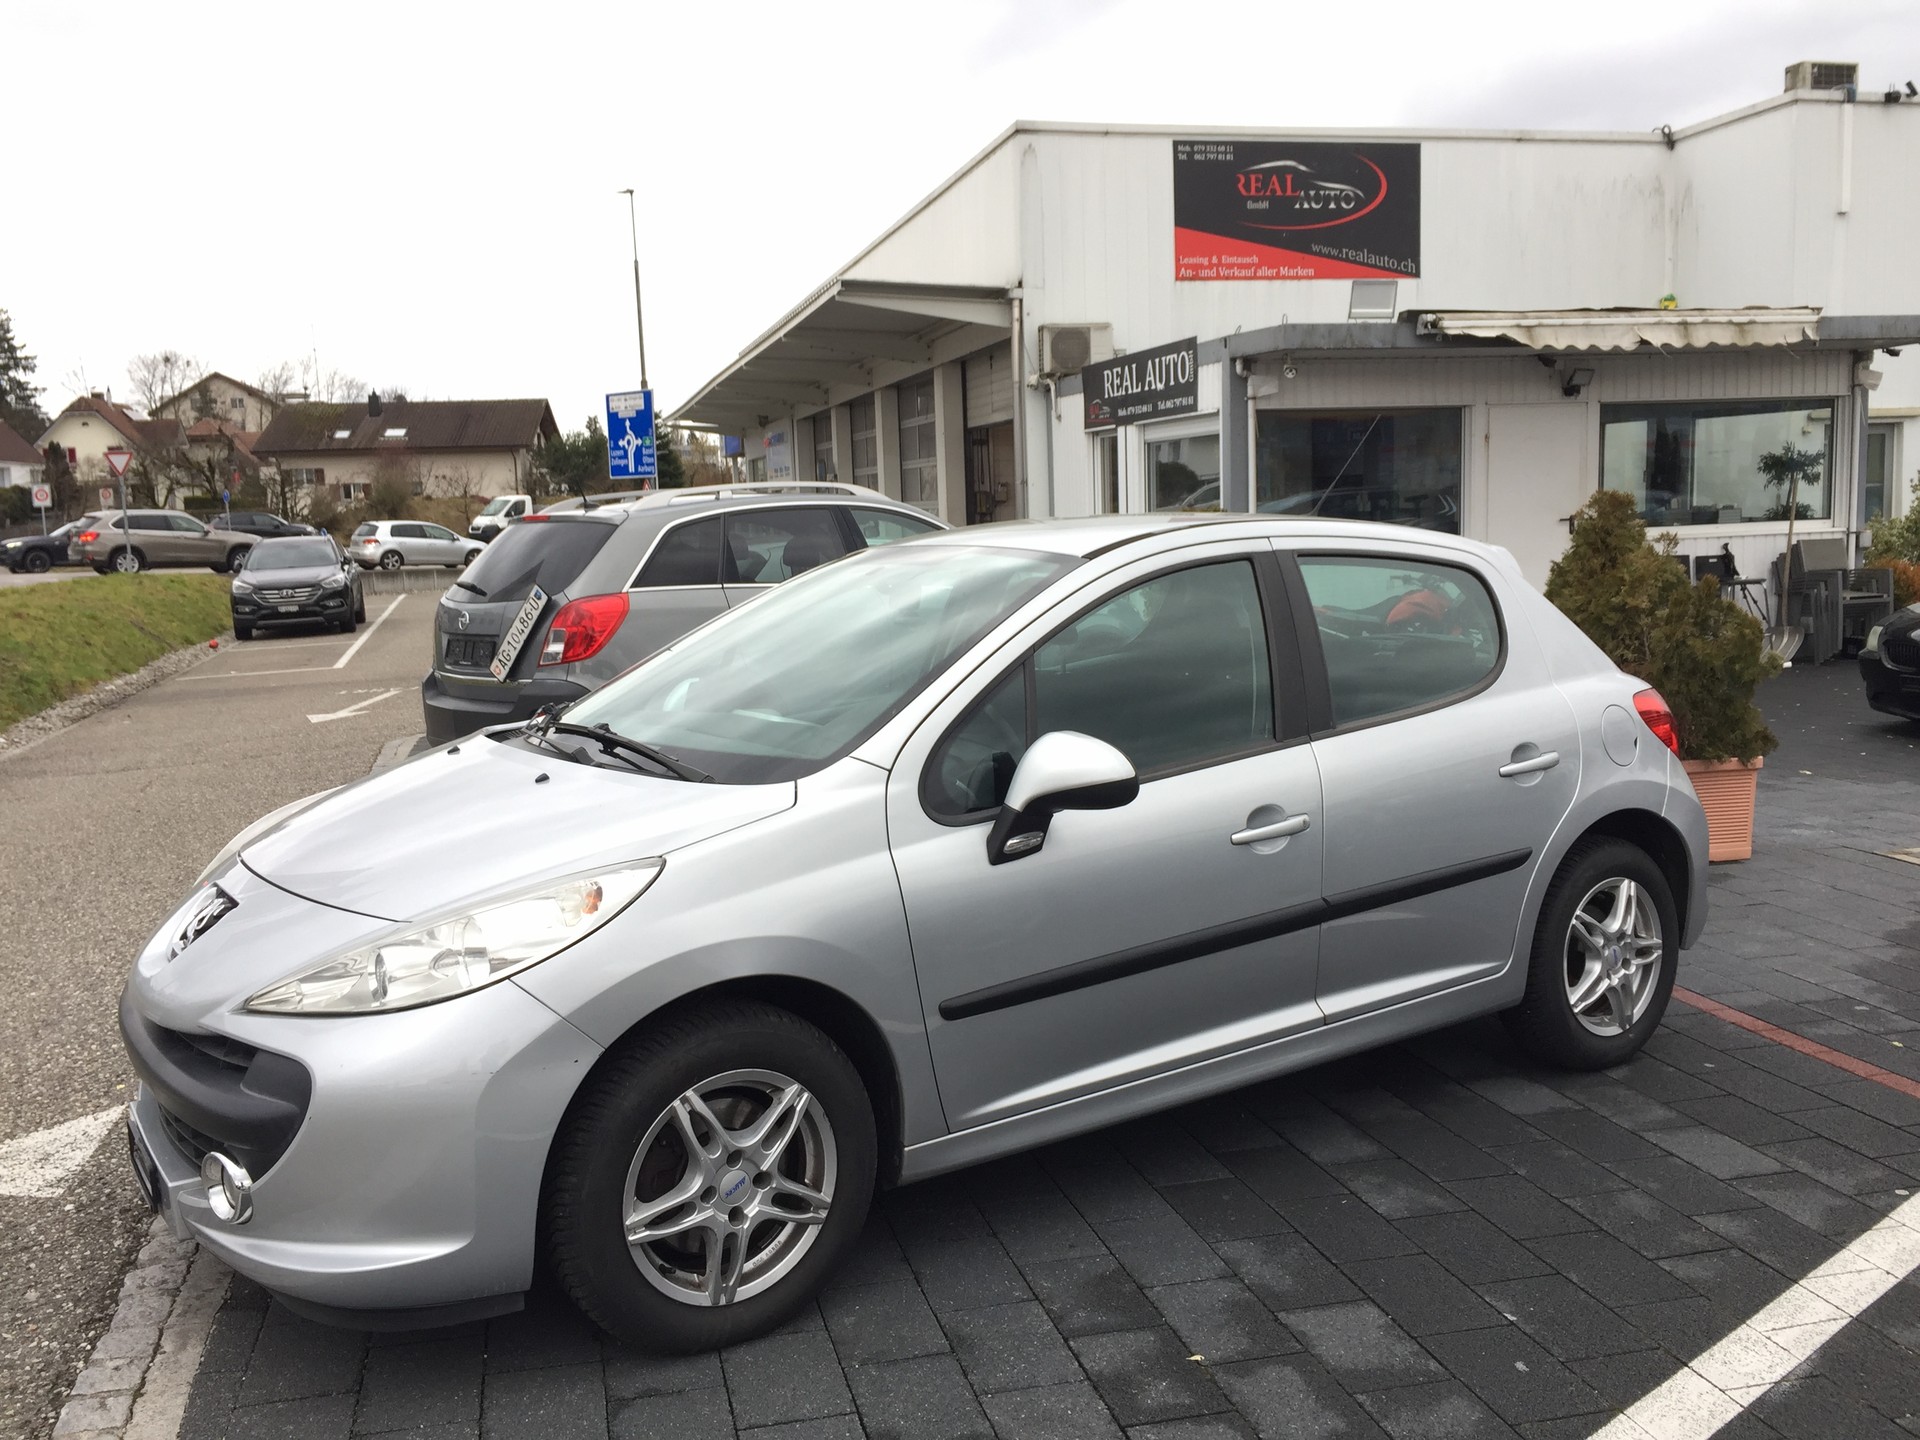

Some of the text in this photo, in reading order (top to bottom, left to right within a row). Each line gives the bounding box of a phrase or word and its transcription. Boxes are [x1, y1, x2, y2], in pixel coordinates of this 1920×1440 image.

[1236, 173, 1299, 196] REAL
[1247, 200, 1269, 209] GmbH
[1294, 190, 1356, 209] AUTO
[1179, 254, 1259, 265] Leasing & Eintausch
[1311, 243, 1416, 274] www.realauto.ch
[1179, 265, 1315, 277] An- und Verkauf aller Marken
[1103, 351, 1190, 399] REAL AUTO
